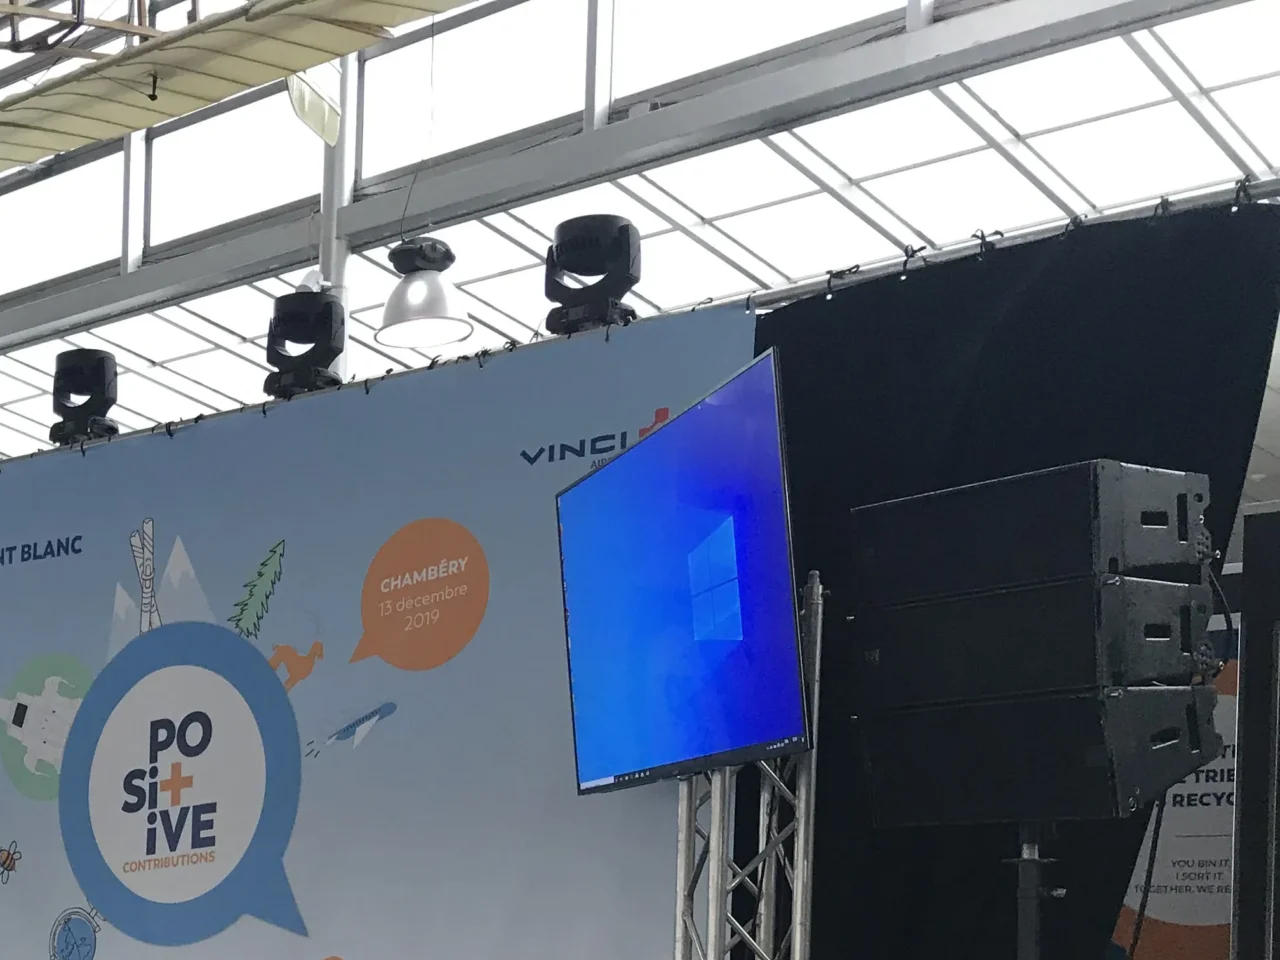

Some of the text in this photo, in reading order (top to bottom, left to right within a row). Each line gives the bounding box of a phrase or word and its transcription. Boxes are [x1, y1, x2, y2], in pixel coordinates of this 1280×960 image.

[520, 431, 627, 466] VINCI
[20, 535, 83, 563] BLANC
[380, 556, 469, 593] CHAMBÉRY
[378, 584, 468, 617] 13 décembre
[404, 608, 440, 631] 2019
[122, 850, 216, 873] CONTRIBUTIONS
[1171, 859, 1194, 868] YOU
